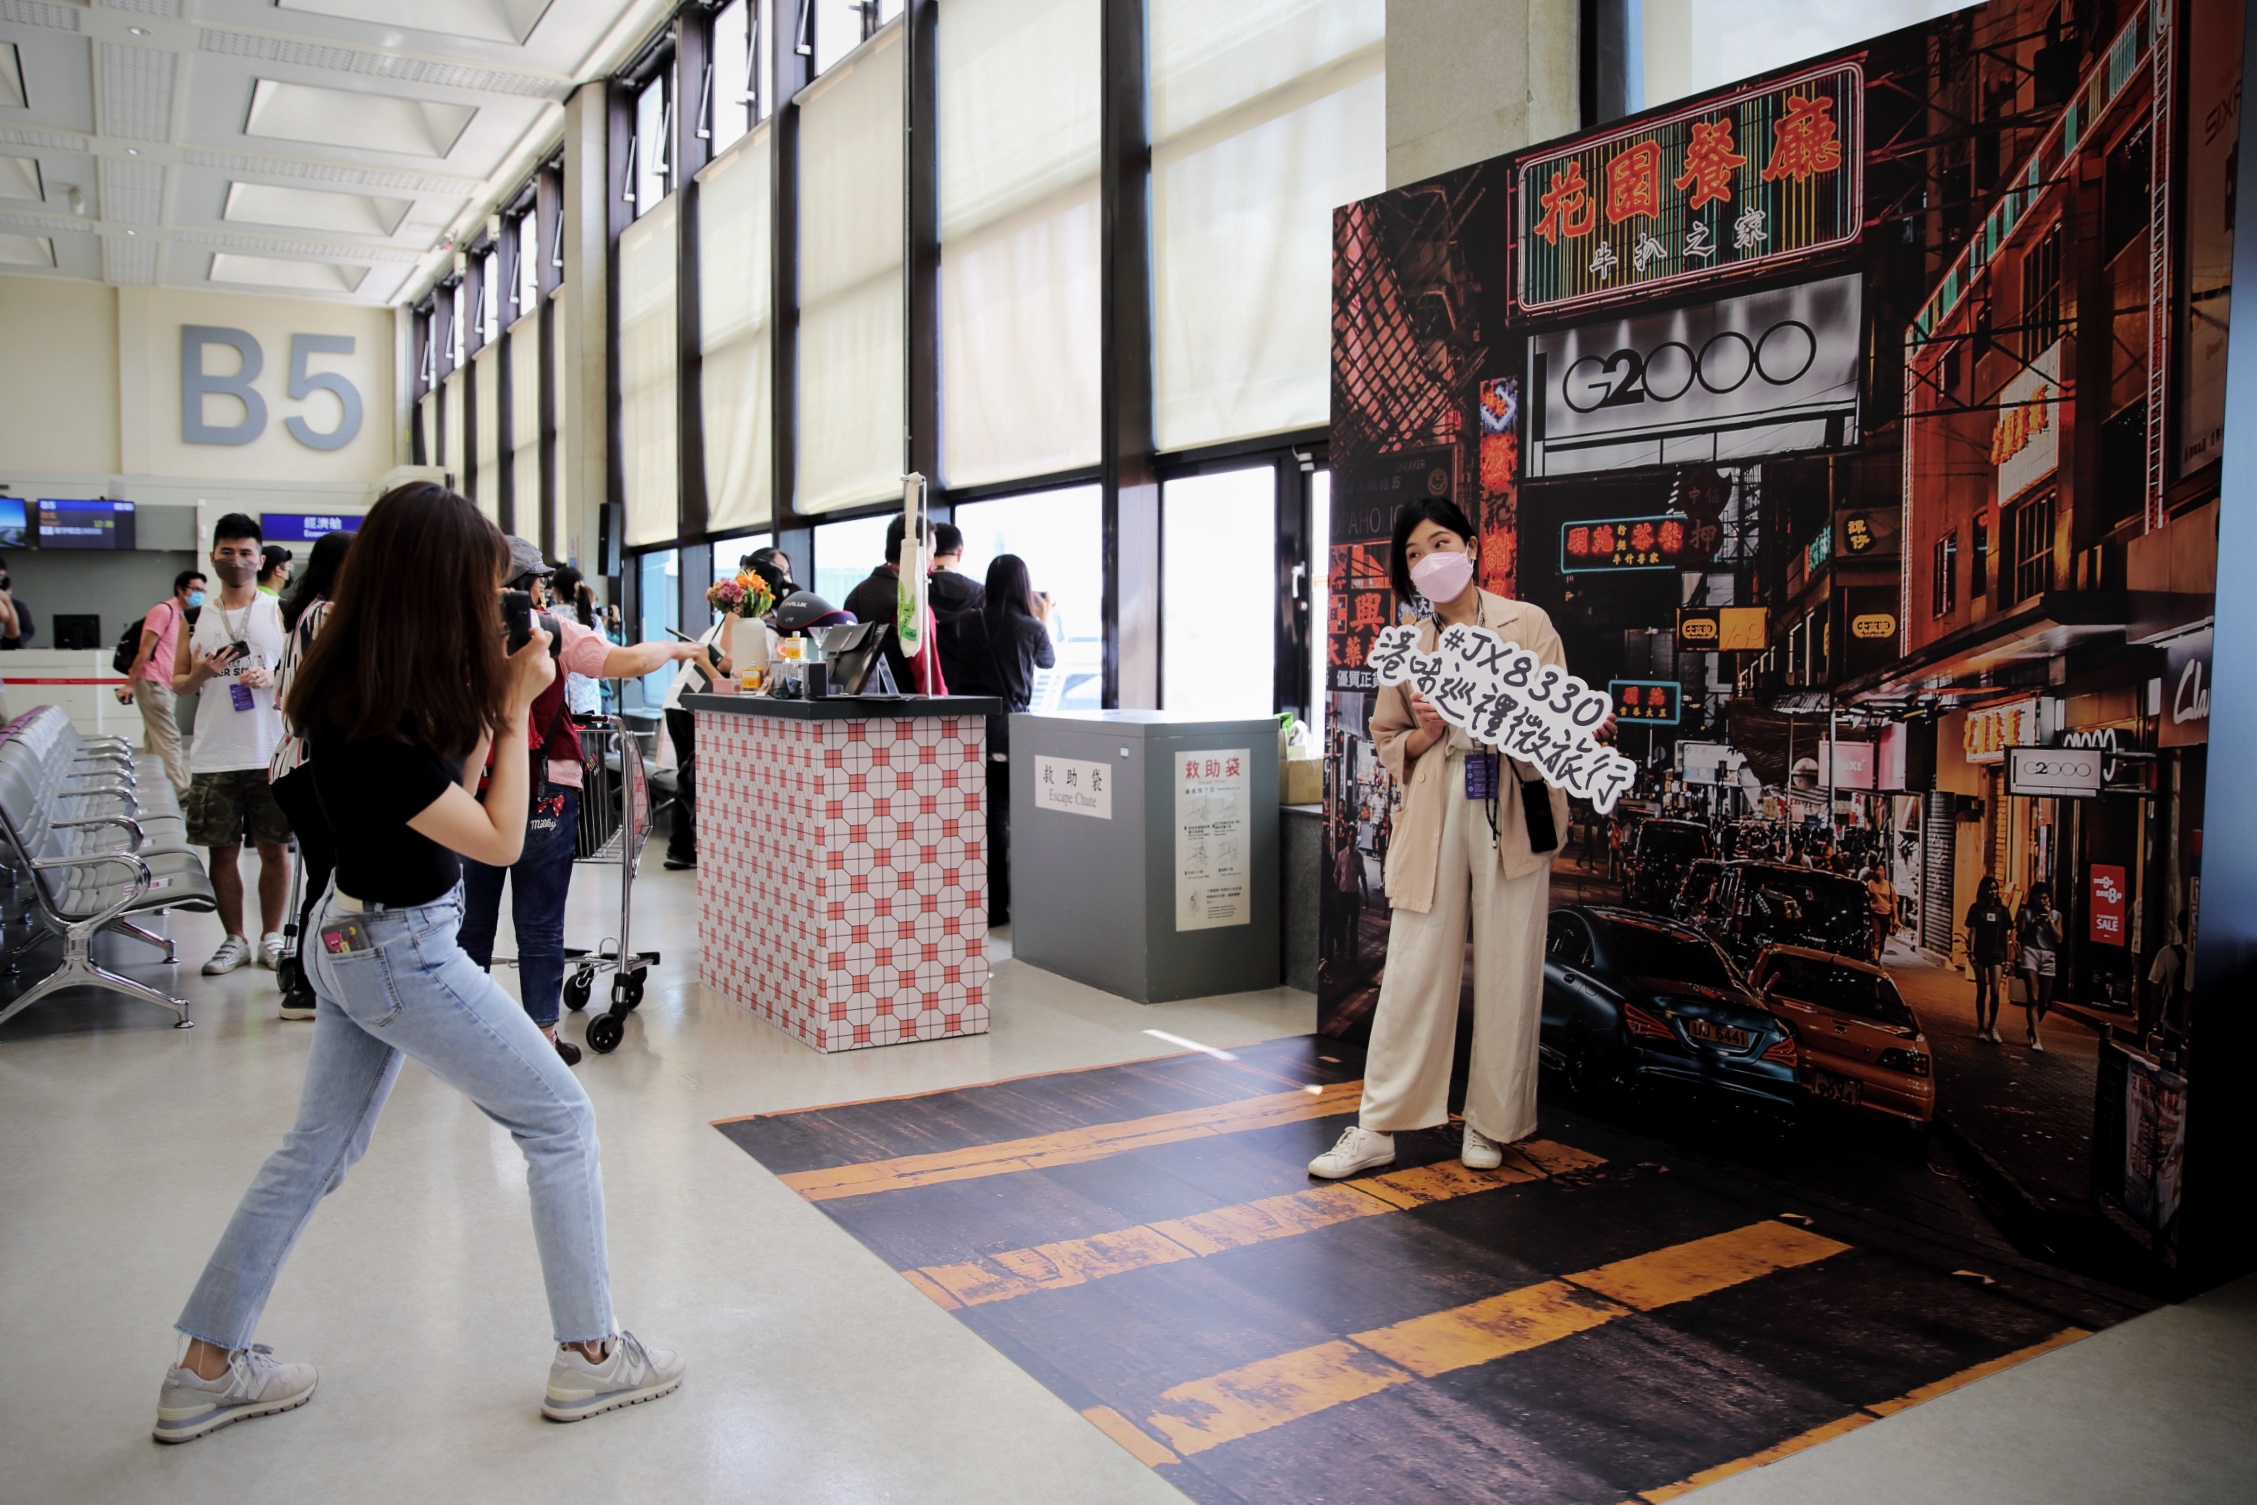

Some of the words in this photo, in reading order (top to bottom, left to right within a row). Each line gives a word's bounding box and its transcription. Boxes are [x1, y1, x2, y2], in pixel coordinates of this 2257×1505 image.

[1534, 96, 1842, 245] 花園餐廳
[1590, 207, 1768, 280] 牛扒之家
[1563, 320, 1817, 414] G2000
[181, 324, 363, 451] B5
[1689, 519, 1718, 551] 押
[1328, 635, 1378, 669] 大藥
[1443, 628, 1605, 727] #JX8330
[1372, 631, 1627, 807] 港味巡禮微旅行
[1043, 764, 1103, 792] 救助袋
[1185, 757, 1241, 780] 救助袋
[2023, 761, 2092, 778] G2000
[1049, 788, 1073, 807] Escape
[1075, 791, 1097, 808] Chute
[530, 818, 557, 832] Milky
[2096, 918, 2119, 932] SALE
[1715, 1027, 1746, 1047] 6441
